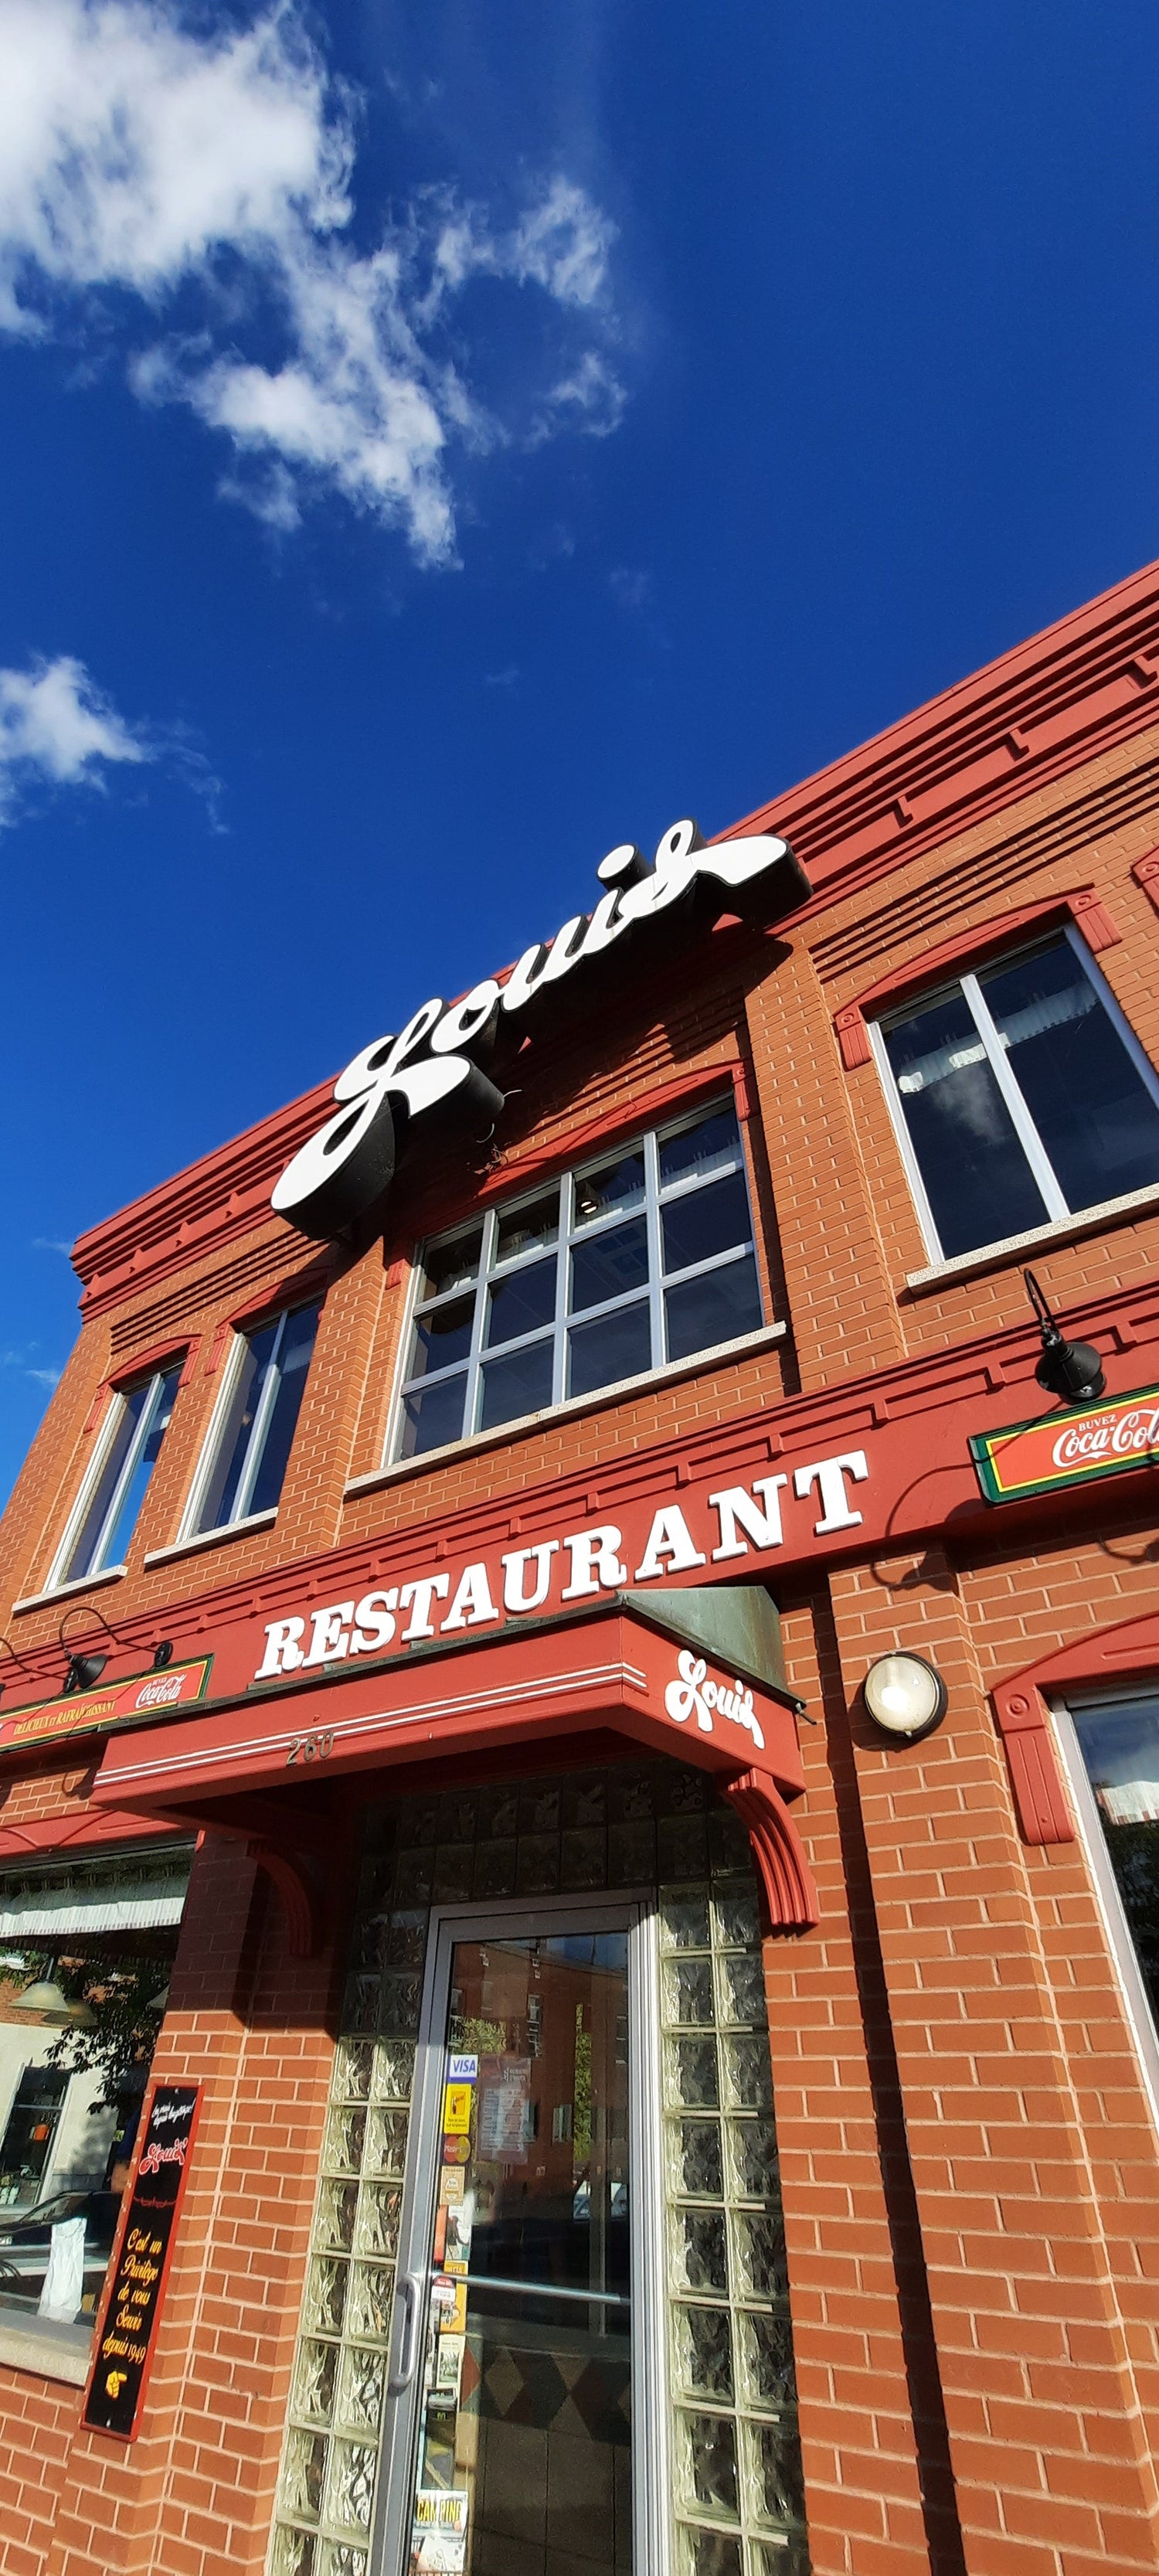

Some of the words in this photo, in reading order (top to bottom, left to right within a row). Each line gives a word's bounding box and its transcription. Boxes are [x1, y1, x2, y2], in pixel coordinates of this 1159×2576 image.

[270, 818, 790, 1213] Louis
[1052, 1405, 1159, 1468] Coca-Col
[1079, 1414, 1118, 1432] BUVEZ
[253, 1449, 869, 1682] RESTAURANT
[664, 1649, 766, 1750] Louis
[286, 1731, 334, 1766] 260
[452, 2059, 476, 2073] VISA
[117, 2281, 130, 2301] de
[131, 2289, 151, 2306] vous
[102, 2329, 130, 2360] depuis
[127, 2343, 147, 2364] 1949
